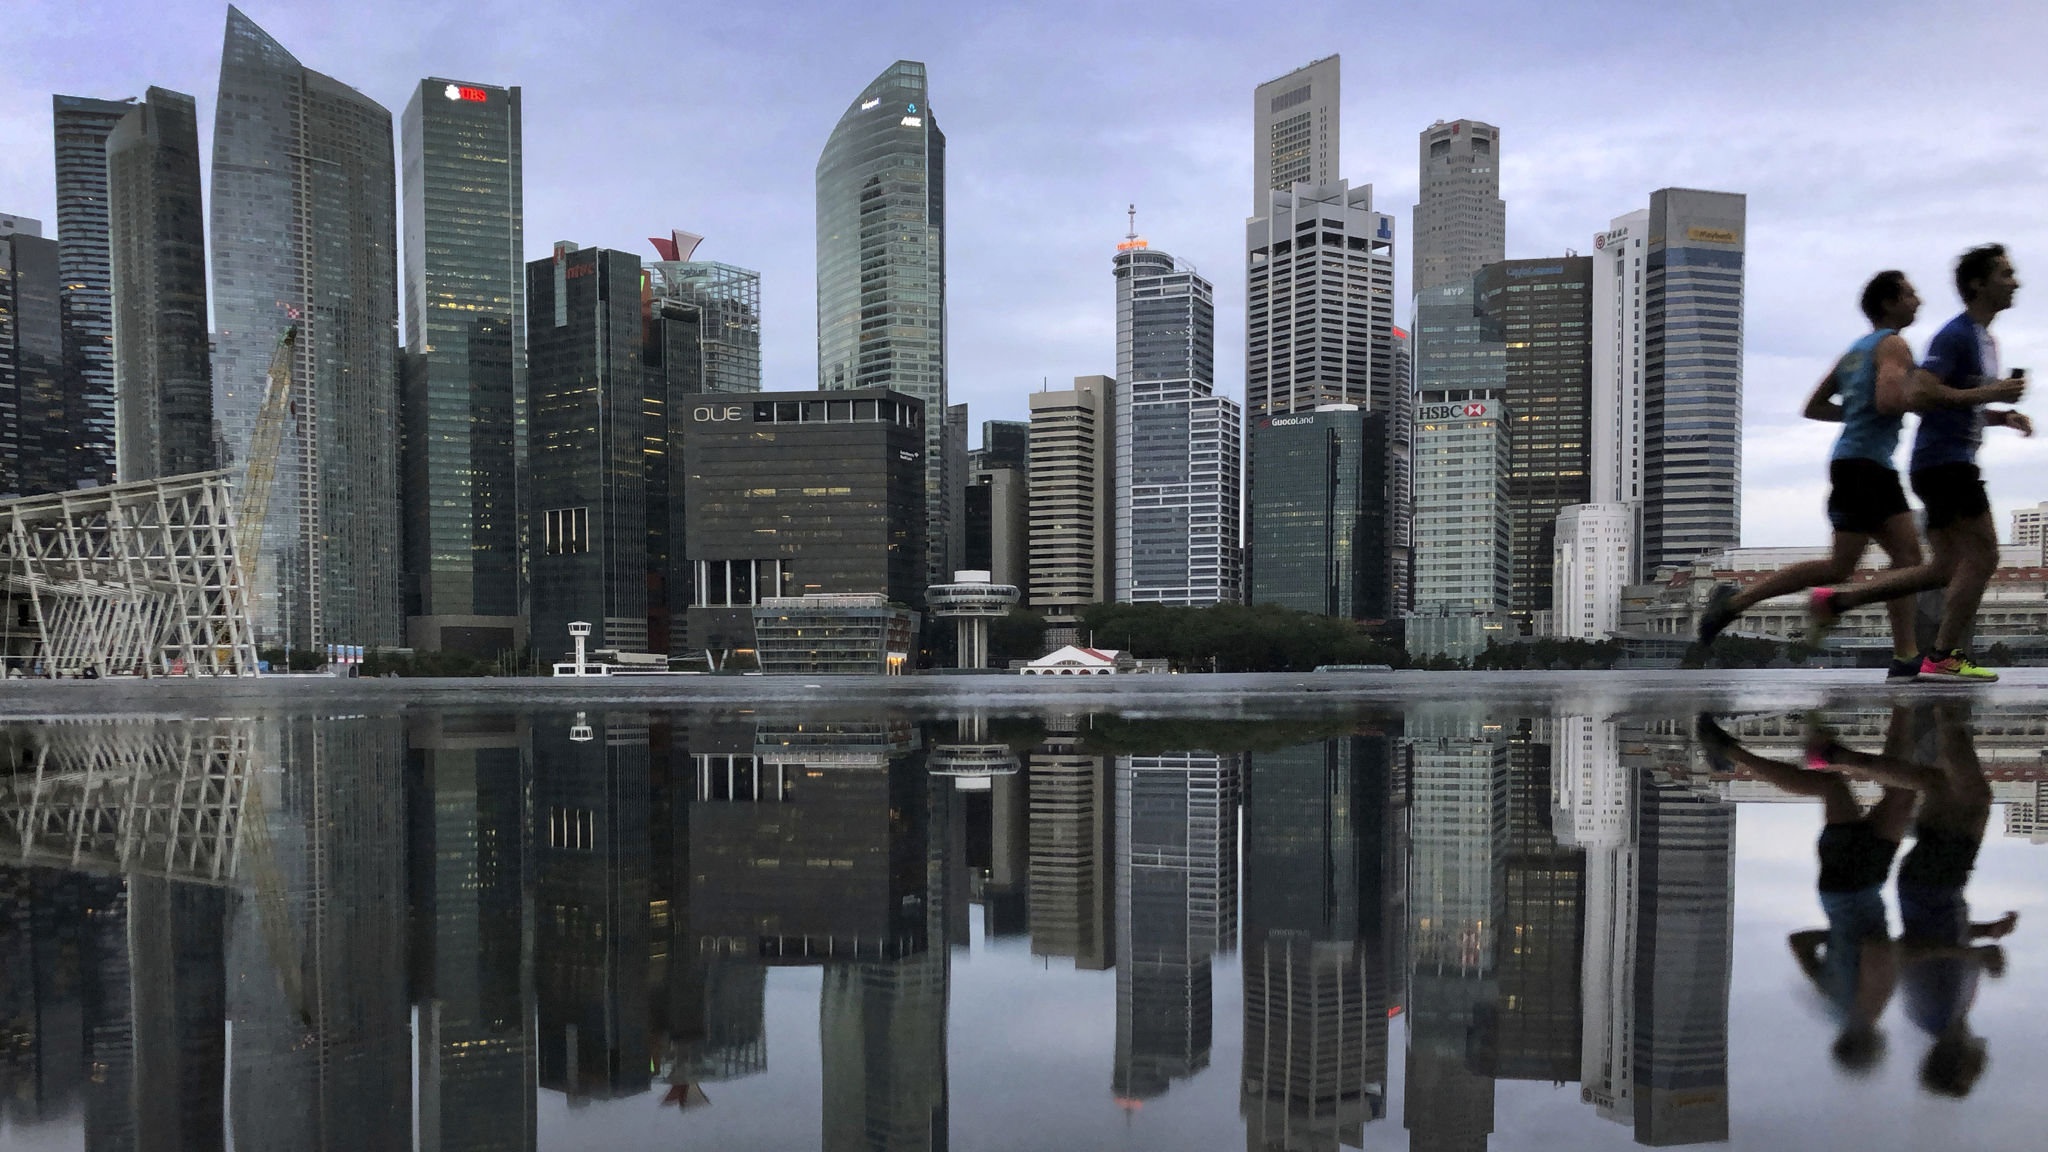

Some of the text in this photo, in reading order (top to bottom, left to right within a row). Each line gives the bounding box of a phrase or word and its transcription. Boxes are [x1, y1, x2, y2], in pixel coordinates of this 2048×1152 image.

[460, 86, 487, 103] UBS
[1443, 287, 1465, 296] MYP
[693, 406, 742, 422] OUE
[1419, 404, 1463, 420] HSBC
[1271, 415, 1314, 427] GuocoLand
